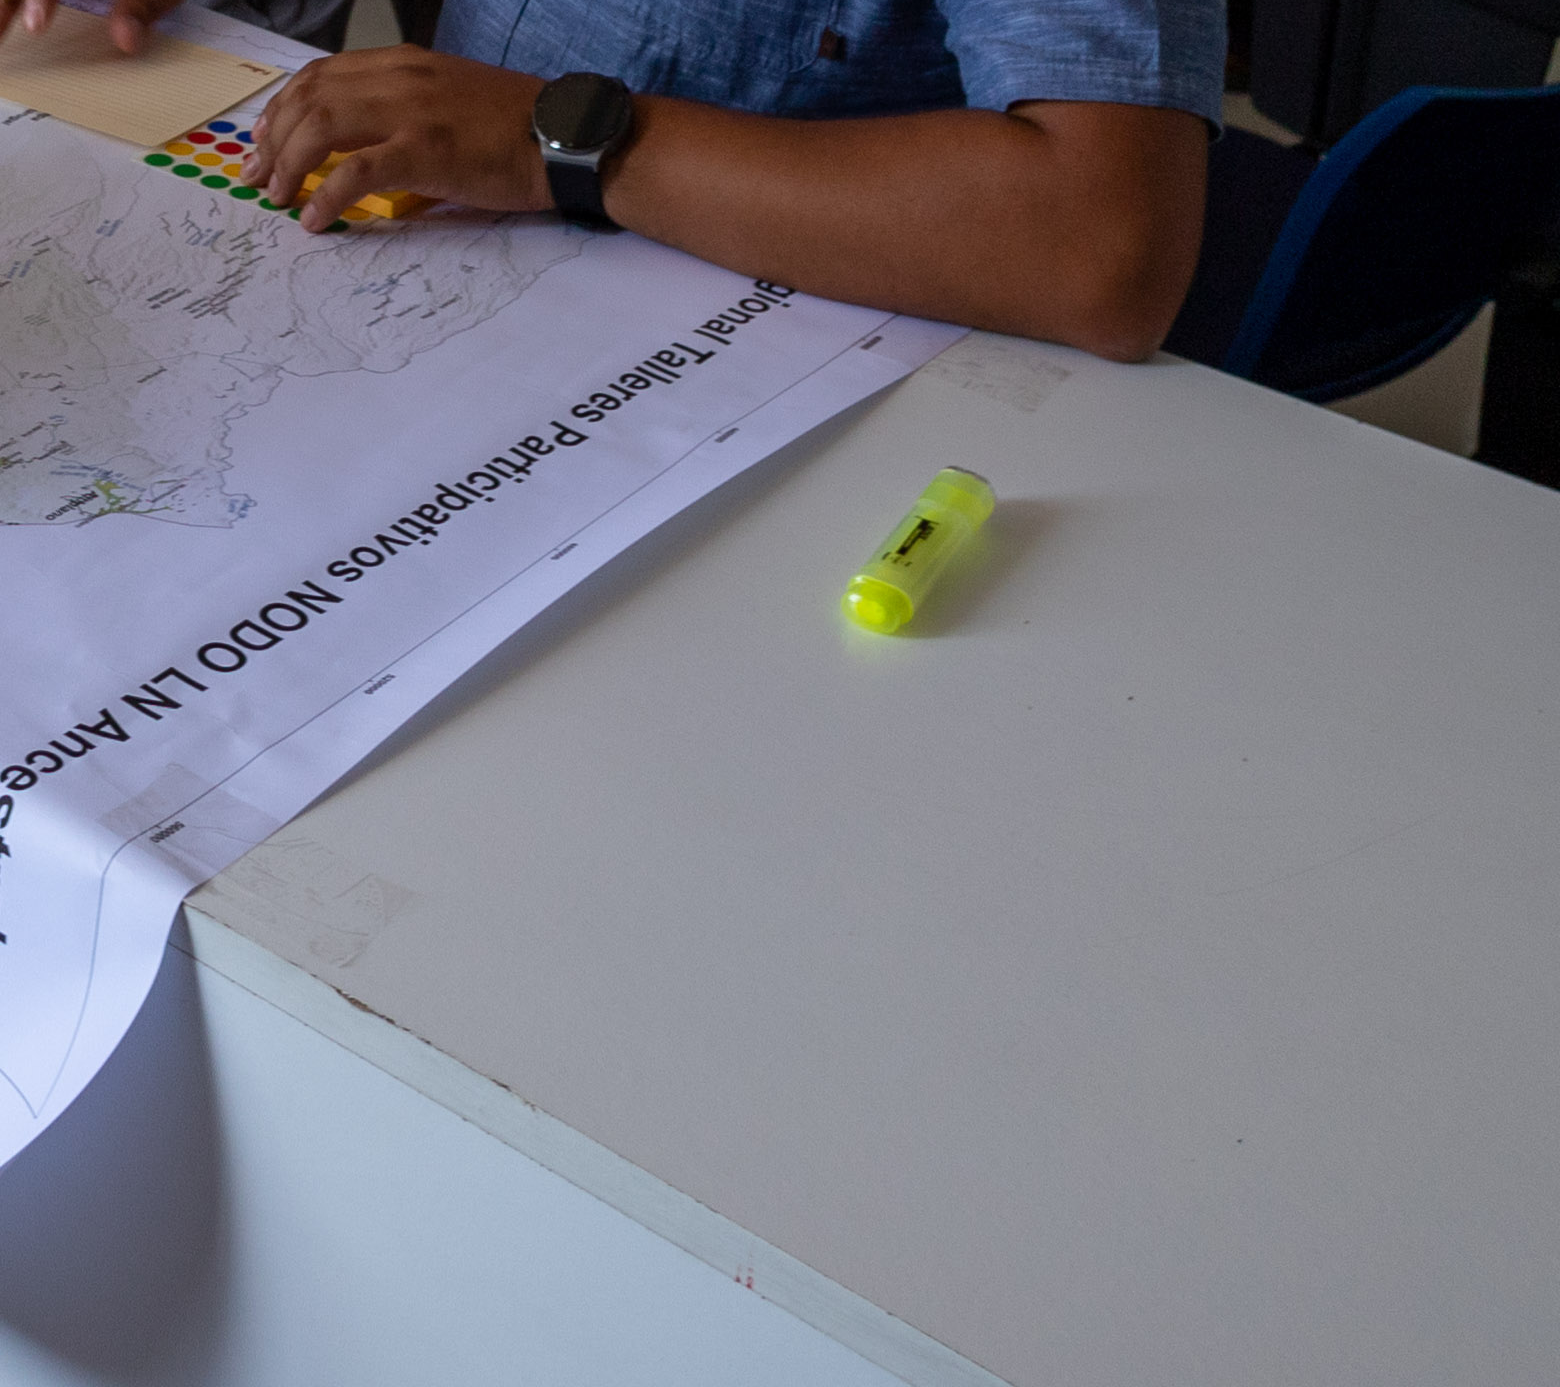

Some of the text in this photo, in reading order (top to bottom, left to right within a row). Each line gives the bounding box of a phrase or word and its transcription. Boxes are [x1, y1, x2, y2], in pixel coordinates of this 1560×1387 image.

[694, 279, 796, 345] gional
[572, 342, 716, 422] Talleres
[328, 420, 589, 582] Participativos
[197, 580, 344, 673] NODO
[121, 666, 209, 721] LN
